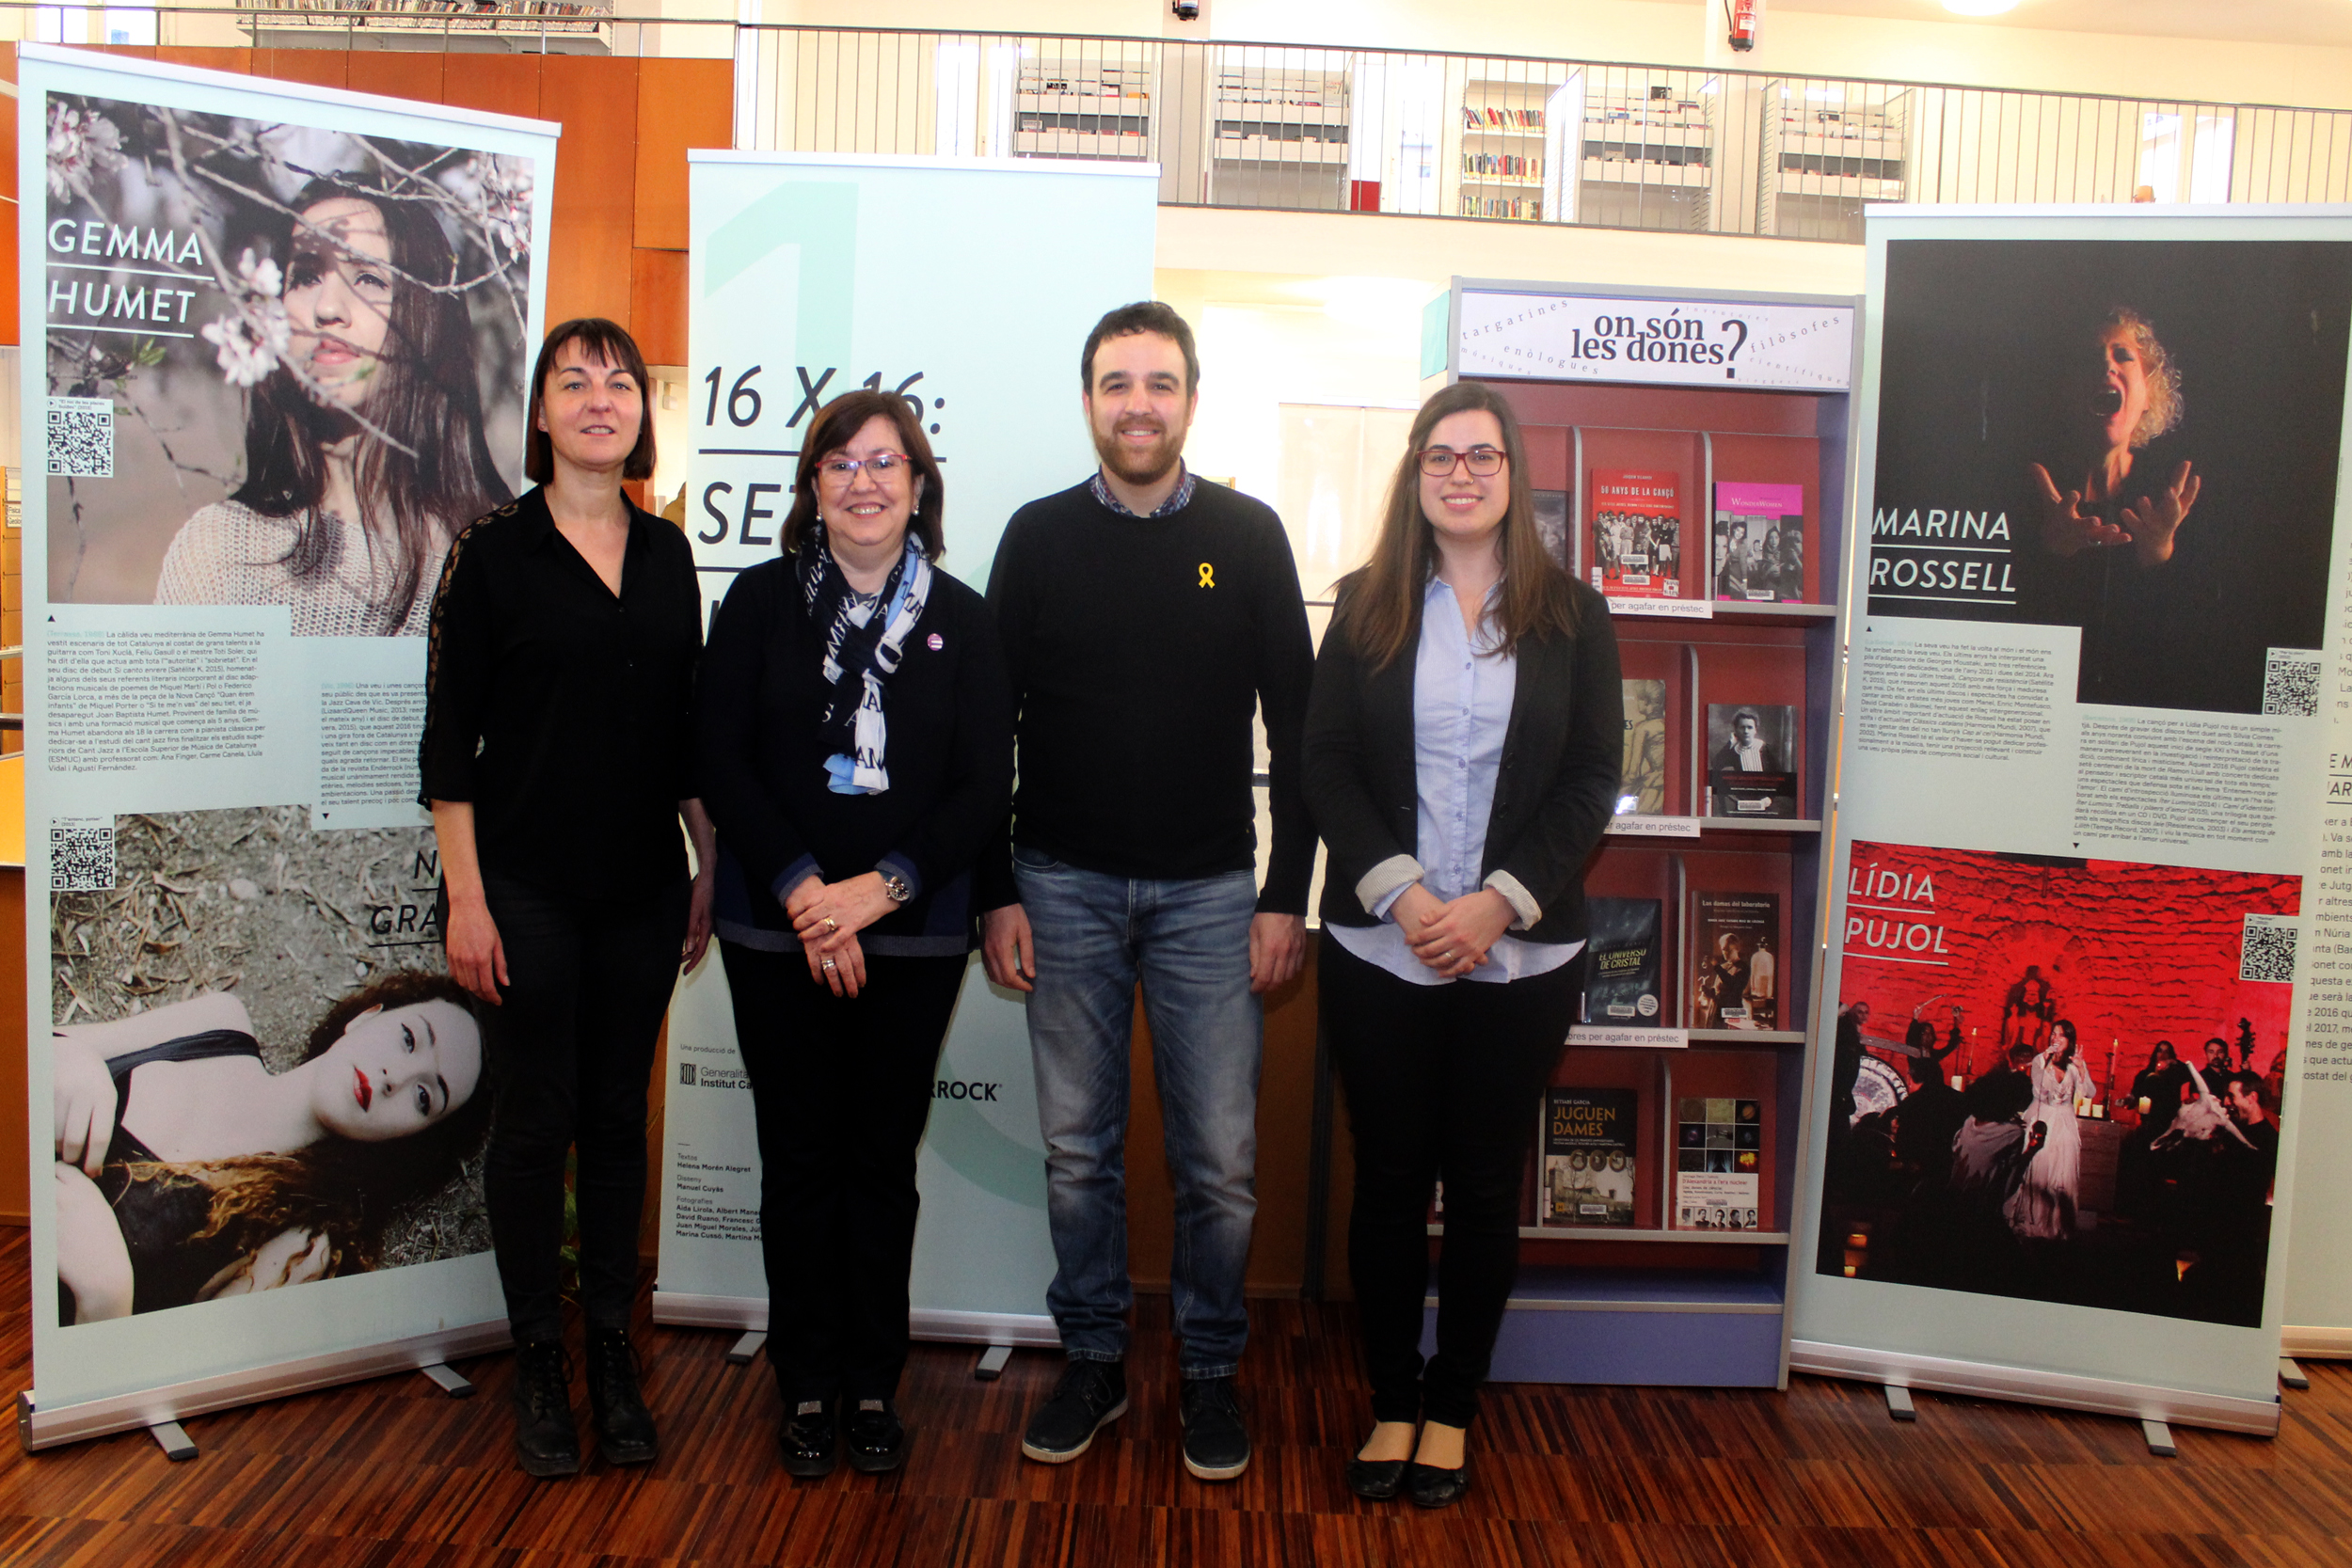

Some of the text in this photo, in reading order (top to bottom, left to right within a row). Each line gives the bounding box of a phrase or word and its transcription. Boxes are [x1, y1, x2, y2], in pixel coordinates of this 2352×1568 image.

[48, 218, 203, 265] GEMMA
[48, 279, 197, 324] HUMET
[1462, 299, 1568, 341] targarines
[1594, 307, 1705, 341] on són
[1750, 316, 1839, 354] filòsofes
[1571, 319, 1748, 379] les dones?
[1503, 345, 1598, 375] enòlogues
[705, 365, 762, 428] 16
[785, 366, 837, 428] X
[1600, 485, 1610, 494] 50
[1612, 485, 1629, 495] ANYS
[1631, 486, 1640, 496] DE
[1642, 487, 1650, 496] LA
[697, 482, 797, 546] SE
[1871, 507, 2010, 541] MARINA
[1869, 556, 2016, 593] ROSSELL
[1629, 602, 1656, 611] agafar
[1672, 603, 1704, 613] préstec
[1615, 820, 1644, 832] agafar
[1659, 821, 1692, 832] préstec
[2321, 849, 2343, 858] amb
[1848, 863, 1935, 903] LÍDIA
[1845, 917, 1949, 954] PUJOL
[1611, 957, 1641, 968] CRISTAL
[2314, 1007, 2339, 1017] 2016
[1589, 1034, 1602, 1044] per
[1605, 1033, 1632, 1044] agafar
[1647, 1033, 1679, 1045] préstec
[2325, 1039, 2338, 1049] de
[693, 1046, 726, 1054] producció
[2309, 1056, 2328, 1066] que
[2331, 1071, 2347, 1081] del
[700, 1078, 736, 1089] Institut
[1553, 1106, 1615, 1121] JUGUEN
[1553, 1121, 1603, 1136] DAMES
[677, 1152, 698, 1161] Textos
[676, 1162, 700, 1170] Helena
[676, 1174, 702, 1183] Disseny
[676, 1183, 723, 1194] Manuel Cuyàs
[676, 1196, 713, 1205] Fotografies
[694, 1223, 717, 1231] Miguel
[701, 1231, 723, 1240] Cussó,
